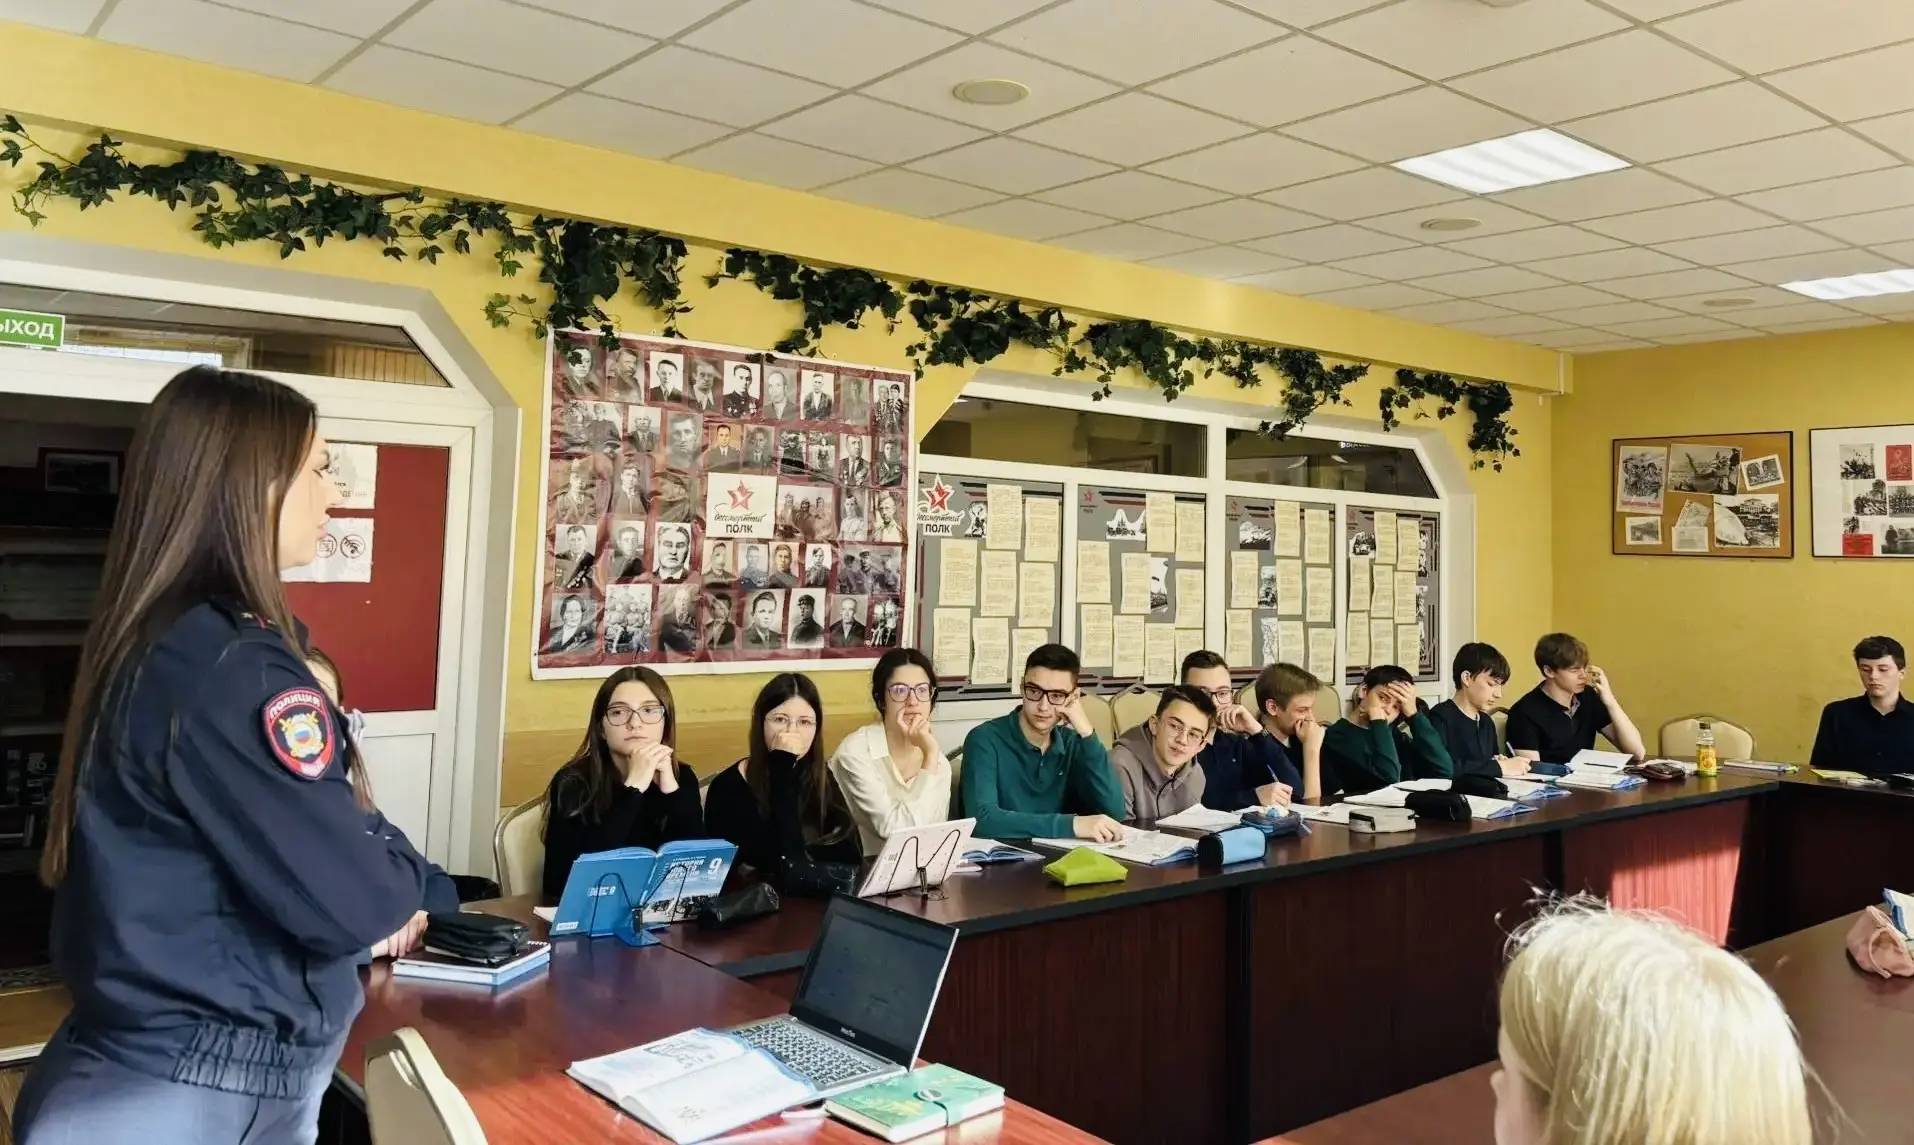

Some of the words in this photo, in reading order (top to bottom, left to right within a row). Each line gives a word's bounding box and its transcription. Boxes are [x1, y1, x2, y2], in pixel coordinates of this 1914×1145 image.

[0, 319, 54, 340] ЫХОД
[726, 524, 753, 533] ПОЛК
[925, 524, 950, 533] ПОЛК
[270, 694, 320, 718] ПОЛИЦИЯ
[707, 857, 722, 875] 9
